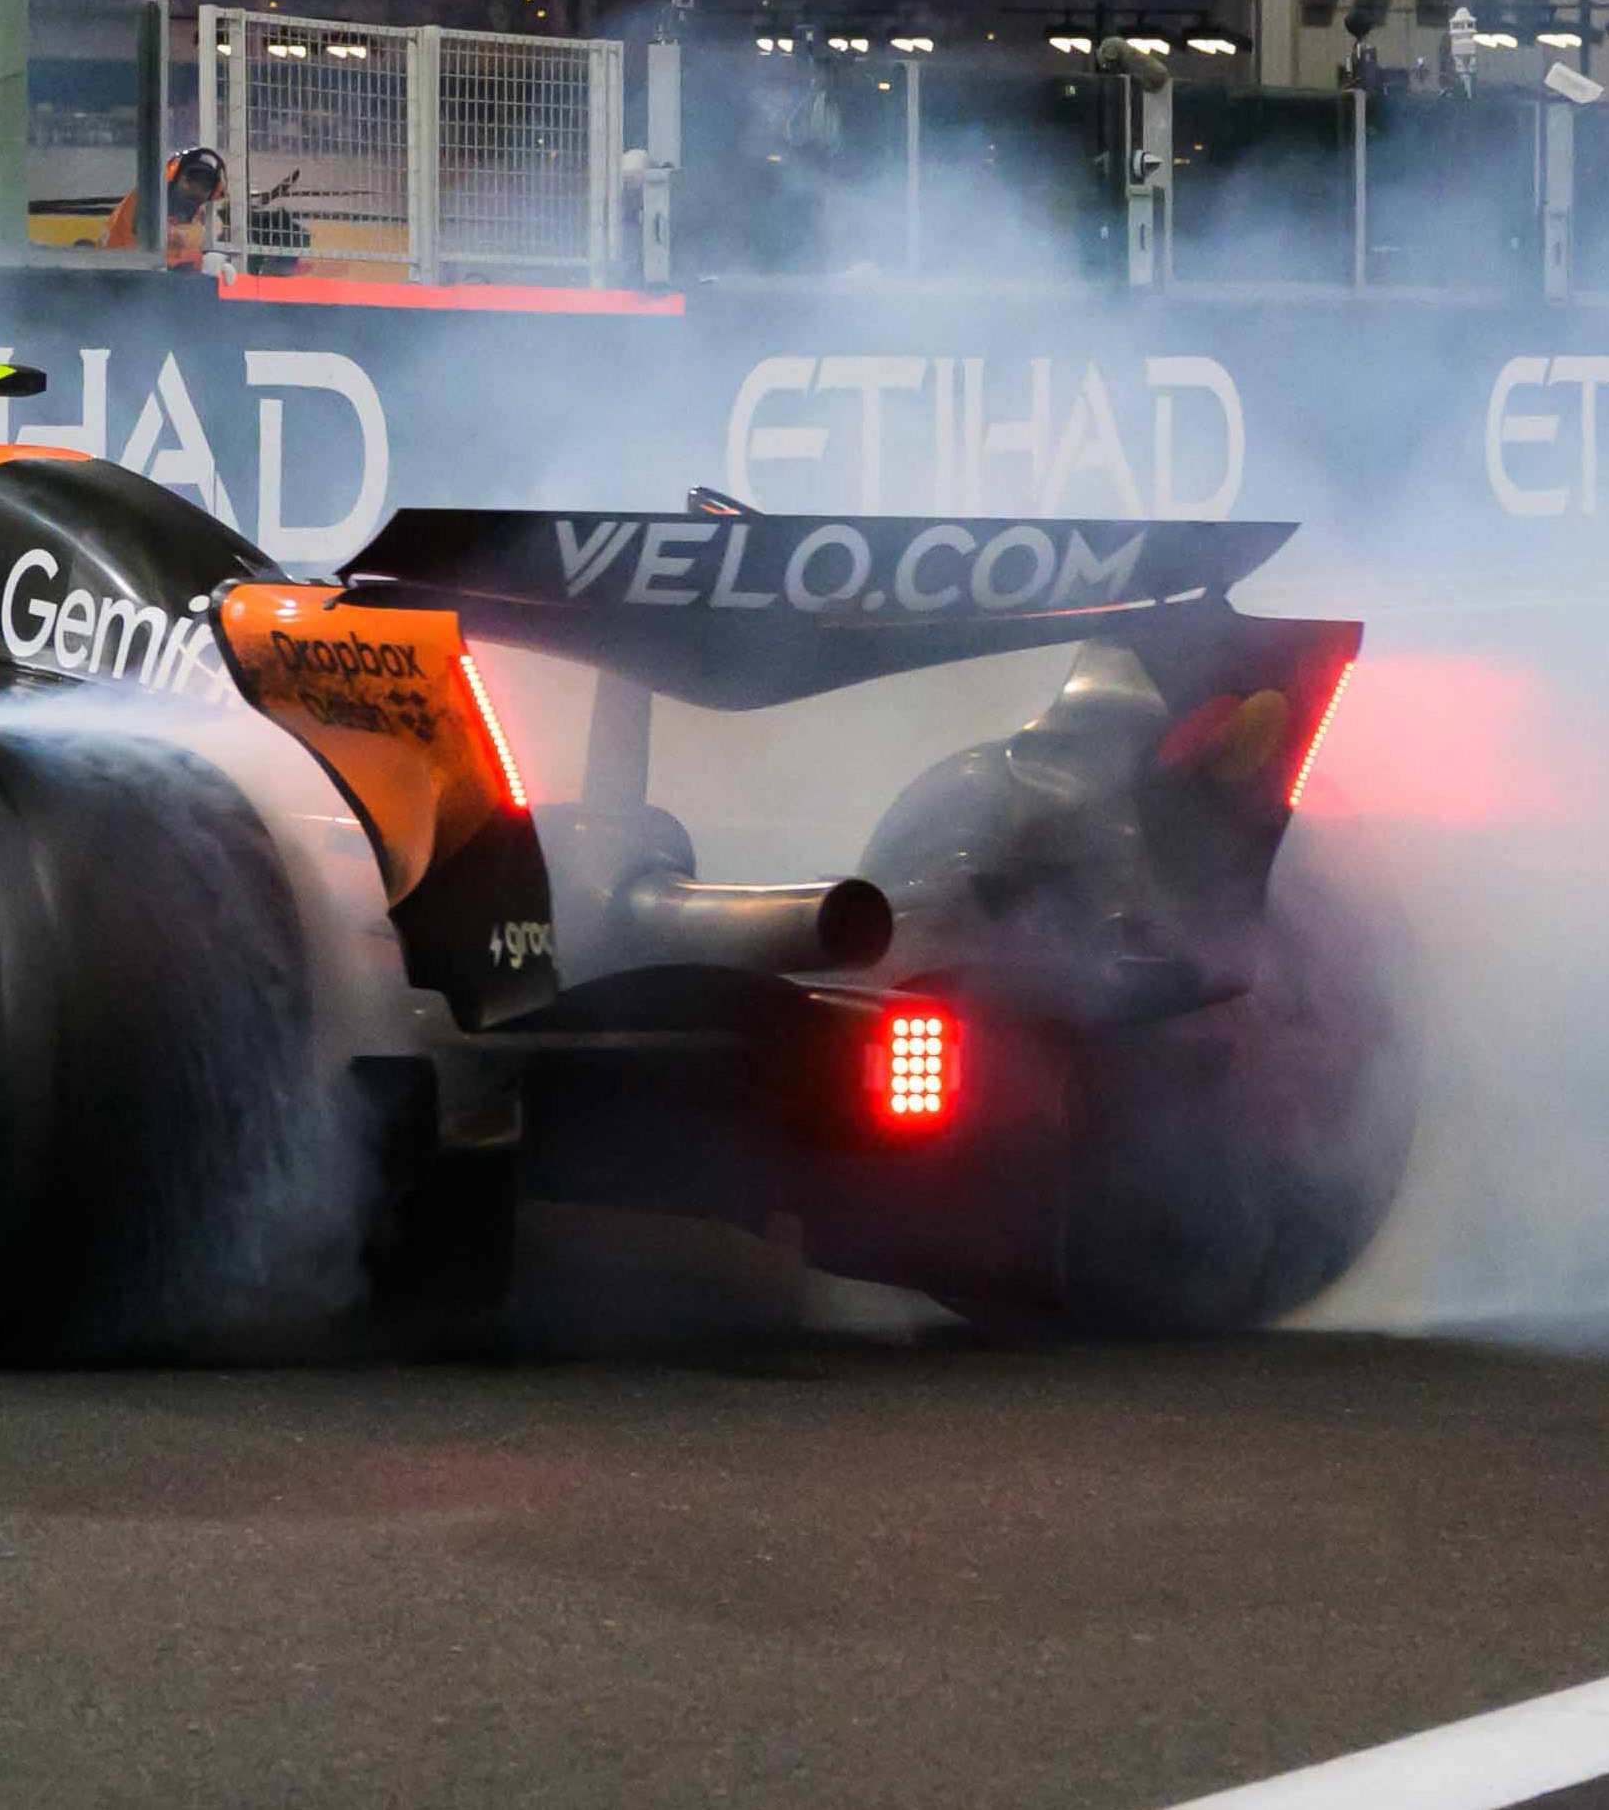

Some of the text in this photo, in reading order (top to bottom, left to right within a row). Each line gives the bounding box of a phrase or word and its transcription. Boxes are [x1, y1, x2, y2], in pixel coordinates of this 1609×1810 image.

[726, 355, 1246, 521] ETIHAD
[555, 518, 1151, 613] VELO.COM
[270, 630, 428, 683] Dropbox
